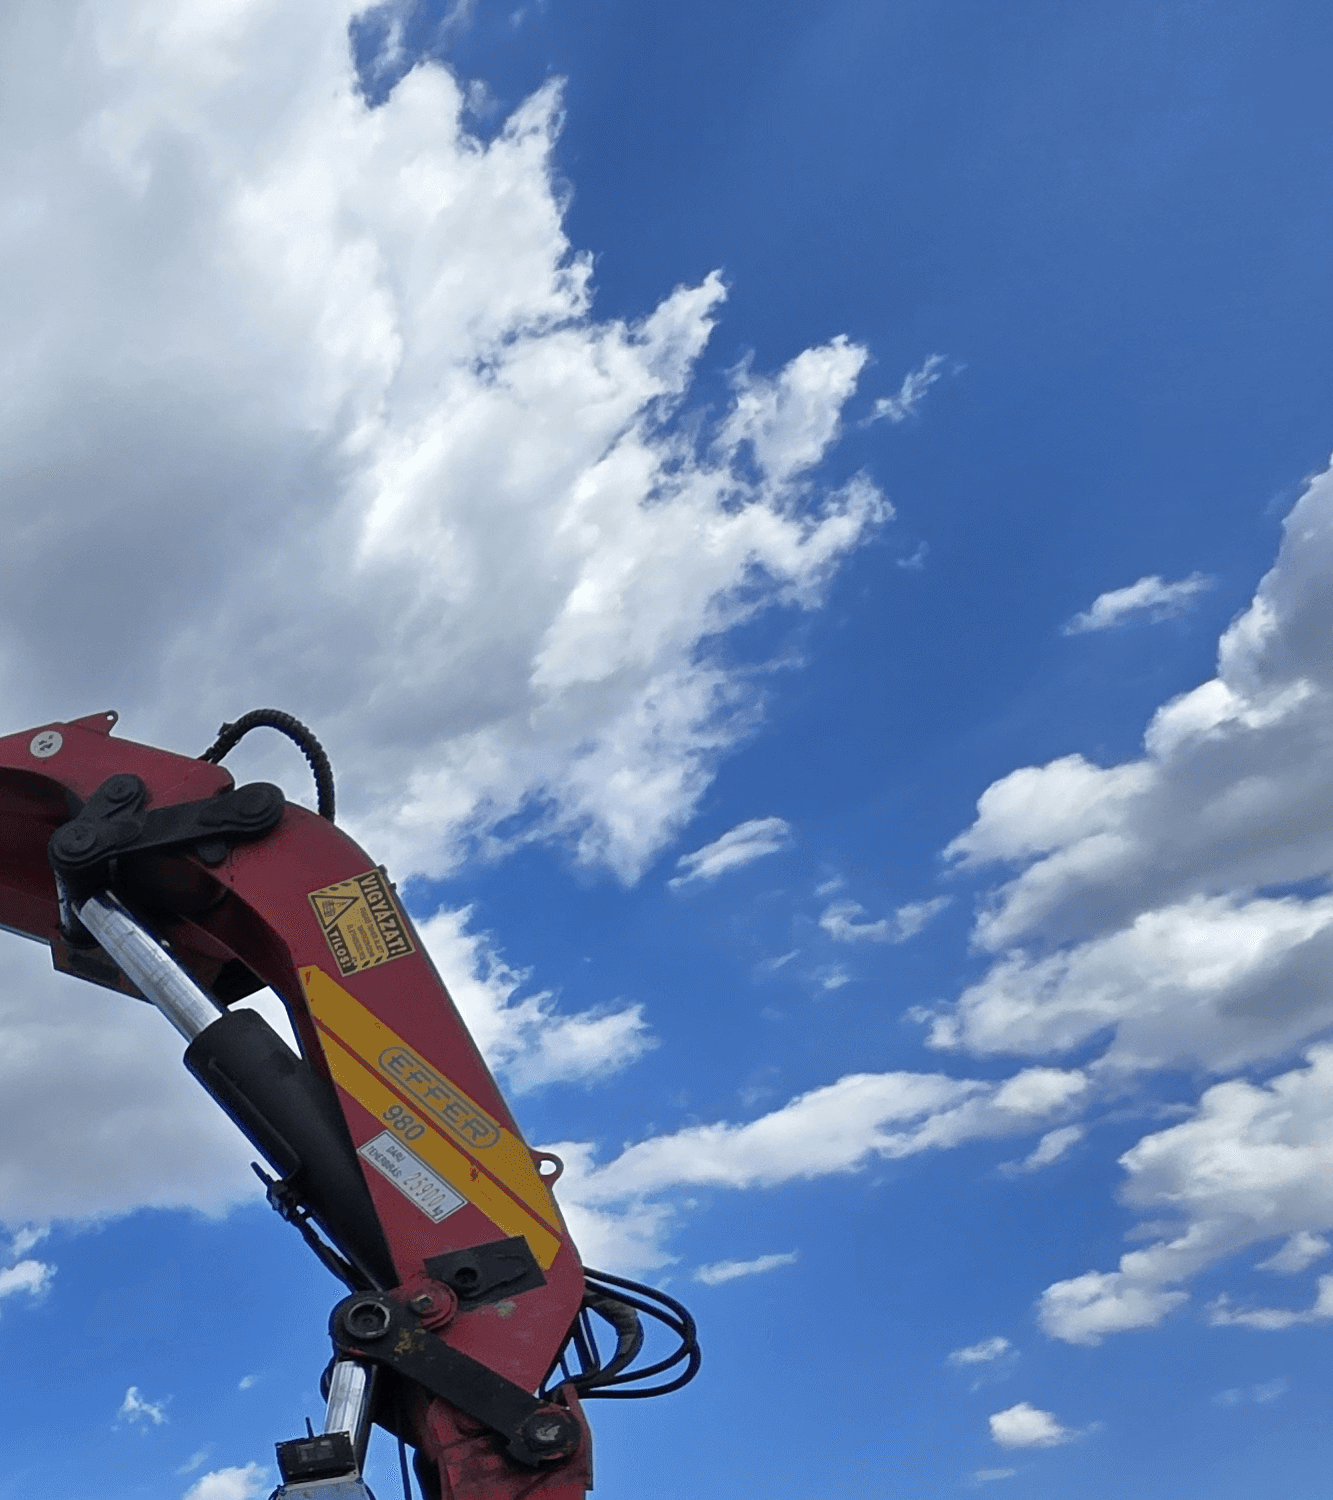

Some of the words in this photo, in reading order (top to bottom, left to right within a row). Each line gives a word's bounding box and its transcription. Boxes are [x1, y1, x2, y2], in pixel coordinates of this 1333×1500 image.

[360, 874, 408, 955] VIGYÁZAT!
[329, 930, 352, 968] TILOS!
[383, 1105, 426, 1141] 980
[387, 1053, 490, 1142] EFFER
